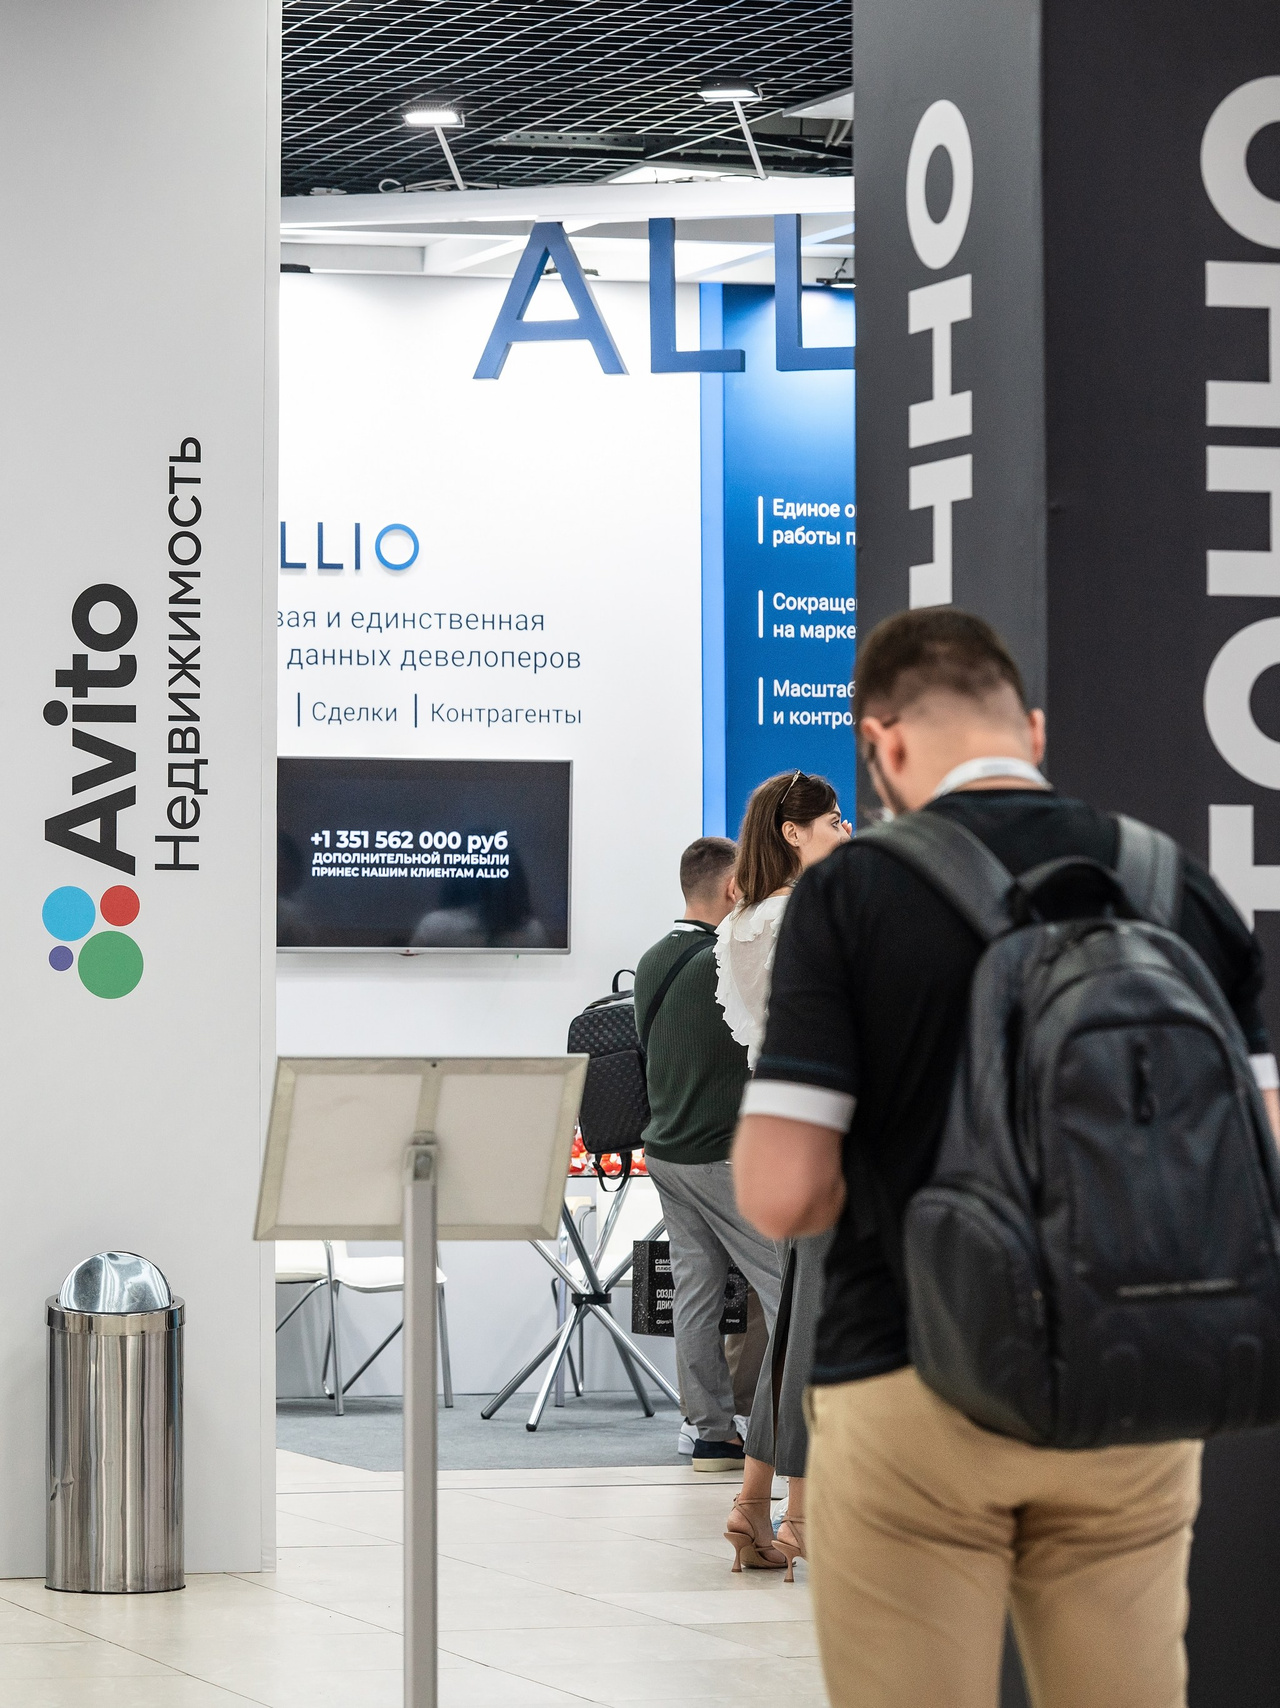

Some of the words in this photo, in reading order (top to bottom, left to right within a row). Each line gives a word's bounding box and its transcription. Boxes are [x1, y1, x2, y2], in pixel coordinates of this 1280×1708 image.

[772, 498, 841, 520] Единое
[844, 503, 857, 518] о
[772, 526, 841, 548] работы
[772, 592, 857, 615] Сокраще
[327, 611, 341, 628] и
[351, 611, 545, 634] единственная
[773, 623, 795, 638] на
[800, 623, 857, 643] марке
[154, 436, 209, 871] Недвижимость
[286, 648, 391, 670] данных
[400, 649, 581, 674] девелоперов
[773, 680, 856, 698] Масштаб
[311, 701, 398, 725] Сделки
[430, 703, 582, 728] Контрагенты
[773, 711, 784, 725] и
[789, 711, 856, 730] контро
[42, 582, 139, 877] Avito
[310, 830, 331, 849] +1
[336, 830, 369, 849] 351
[375, 830, 414, 850] 562
[419, 831, 462, 850] 000
[467, 830, 508, 854] руб
[312, 852, 441, 866] ДОПОЛНИТЕЛЬНОЙ
[443, 854, 510, 866] ПРИБЫЛИ
[311, 866, 360, 878] ПРИНЕС
[361, 867, 408, 878] НАШИМ
[410, 867, 474, 879] КЛИЕНТАМ
[475, 868, 510, 879] ALLIO
